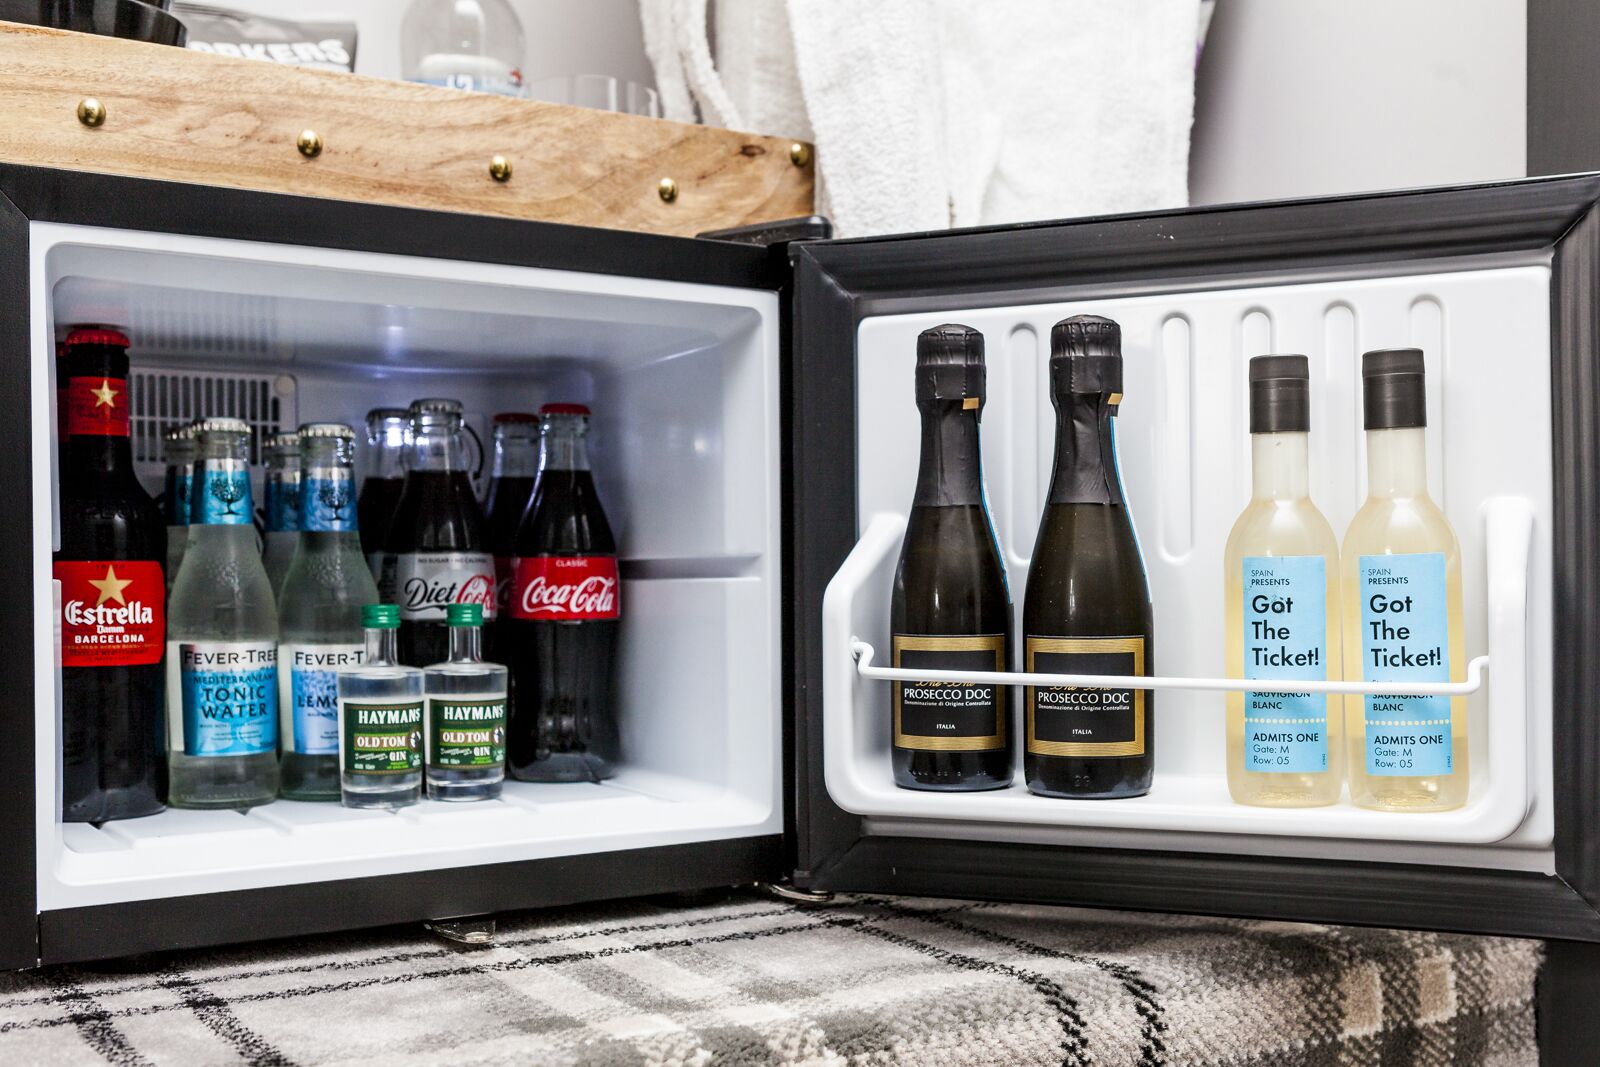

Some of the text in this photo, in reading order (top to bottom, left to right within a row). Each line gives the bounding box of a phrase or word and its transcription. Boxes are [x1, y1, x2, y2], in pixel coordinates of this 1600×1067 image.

[1251, 569, 1273, 577] SPAIN
[1368, 568, 1391, 576] SPAIN
[1251, 578, 1290, 586] PRESENTS
[1368, 577, 1409, 585] PRESENTS
[405, 577, 456, 612] Diet
[522, 576, 615, 613] Coca-Cola
[1252, 594, 1293, 614] Got
[1369, 594, 1412, 613] Got
[64, 600, 153, 626] Estrella
[1252, 619, 1290, 640] The
[1370, 619, 1410, 640] The
[74, 634, 144, 644] BARCELONA
[184, 649, 278, 665] FEVER-TREE
[1252, 645, 1319, 667] Ticket!
[1371, 645, 1441, 667] Ticket!
[203, 686, 265, 702] TONIC
[904, 688, 991, 700] PROSECCO DOC
[1038, 692, 1129, 704] PROSECCO DOC
[201, 703, 267, 719] WATER
[1252, 701, 1282, 710] BLANC
[1373, 703, 1403, 711] BLANC
[357, 736, 406, 747] OLD TOM
[442, 731, 490, 743] OLD TOM
[1253, 733, 1319, 743] ADMITS ONE
[1374, 735, 1443, 745] ADMITS ONE
[473, 747, 490, 756] GIN
[1253, 744, 1290, 754] Gate: M
[1374, 747, 1413, 757] Gate: M
[389, 751, 406, 761] GIN
[1253, 755, 1290, 765] Row: 05
[1375, 758, 1413, 768] Row: 05
